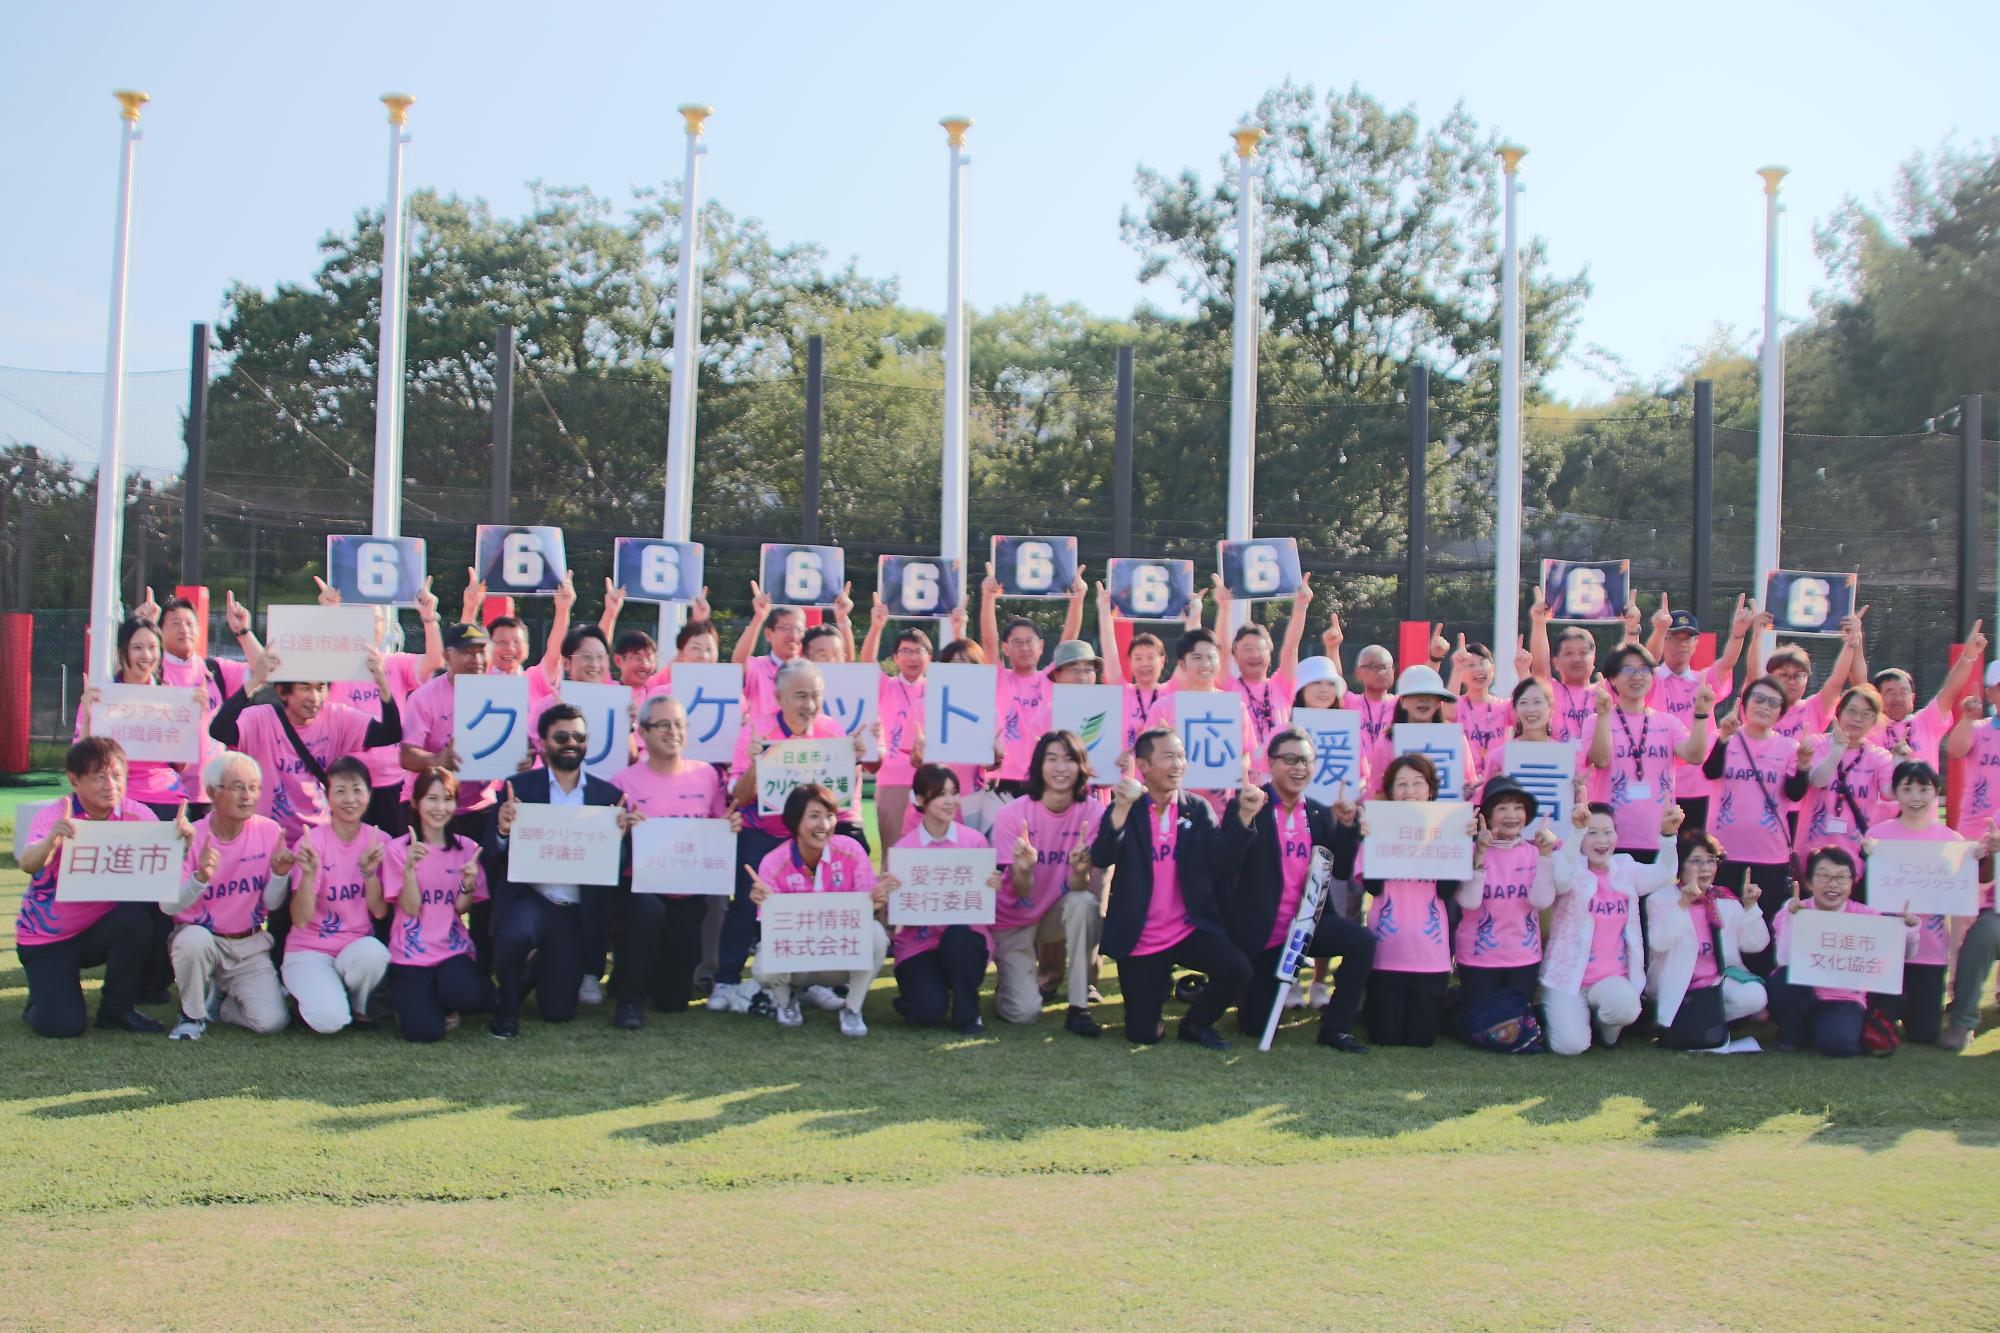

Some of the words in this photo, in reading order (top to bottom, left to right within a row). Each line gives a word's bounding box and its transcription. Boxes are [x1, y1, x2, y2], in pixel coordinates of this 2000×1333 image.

[357, 543, 398, 597] 6
[503, 533, 543, 587] 6
[640, 545, 680, 595] 6
[785, 551, 822, 600] 6
[1016, 541, 1053, 590] 6
[1243, 545, 1280, 593] 6
[902, 562, 939, 611] 6
[1131, 565, 1169, 614] 6
[1566, 567, 1605, 615] 6
[1786, 577, 1830, 627] 6
[280, 634, 368, 651] 日進市議会
[466, 699, 517, 760] ク
[687, 686, 739, 743] ケ
[941, 685, 980, 744] ト
[1185, 711, 1236, 768] 応
[1399, 826, 1443, 841] 日進市
[69, 843, 171, 875] 日進市
[911, 864, 973, 886] 愛学祭
[204, 875, 264, 900] JAPAN
[899, 891, 984, 912] 実行委員
[1483, 884, 1529, 899] JAPA
[774, 909, 861, 931] 三井情報
[1821, 931, 1878, 952] 日進市
[773, 935, 860, 958] 株式会社
[1808, 952, 1886, 975] 文化協会
